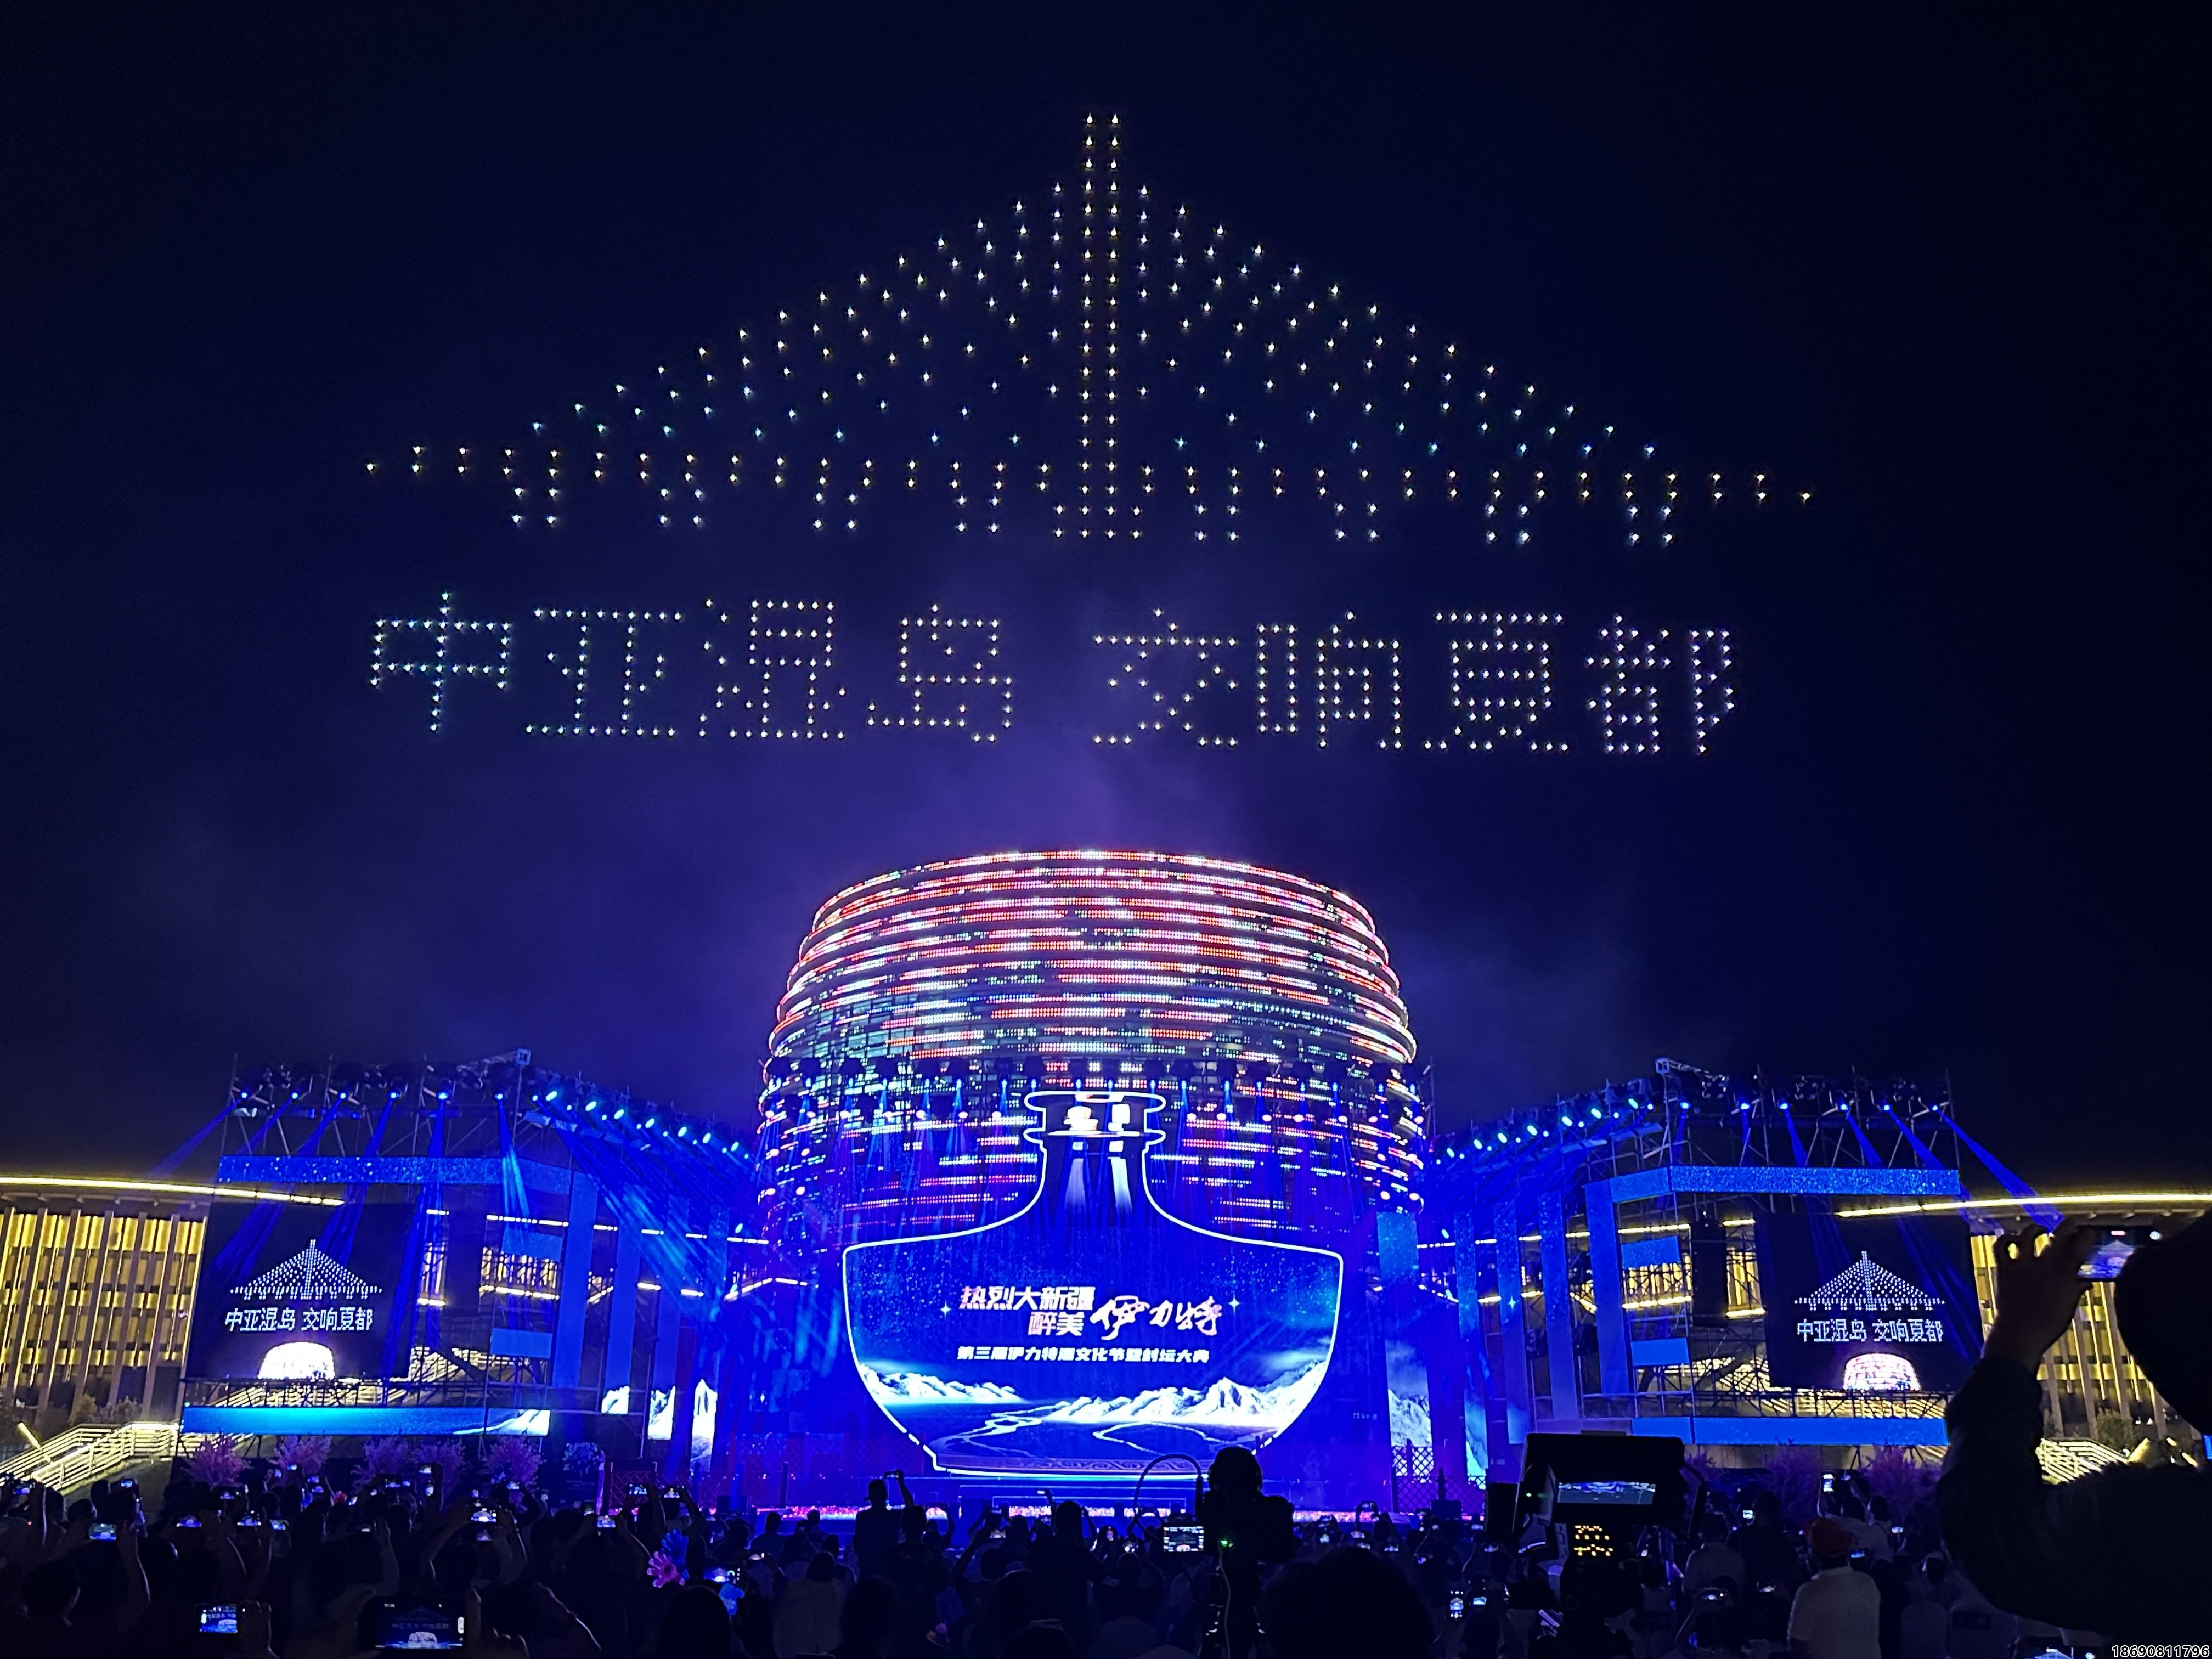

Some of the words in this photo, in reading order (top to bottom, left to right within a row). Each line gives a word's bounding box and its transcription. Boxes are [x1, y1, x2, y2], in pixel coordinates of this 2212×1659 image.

[371, 593, 1012, 742] 中亚湿岛
[1094, 608, 1734, 752] 交响夏都
[959, 1286, 1096, 1311] 热烈大新疆
[225, 1307, 295, 1331] 中亚湿岛
[301, 1307, 373, 1330] 交响夏都
[1028, 1312, 1085, 1336] 醉美
[1090, 1295, 1222, 1340] 伊力特
[1797, 1319, 1866, 1342] 中亚湿岛
[1872, 1318, 1943, 1342] 交响夏都
